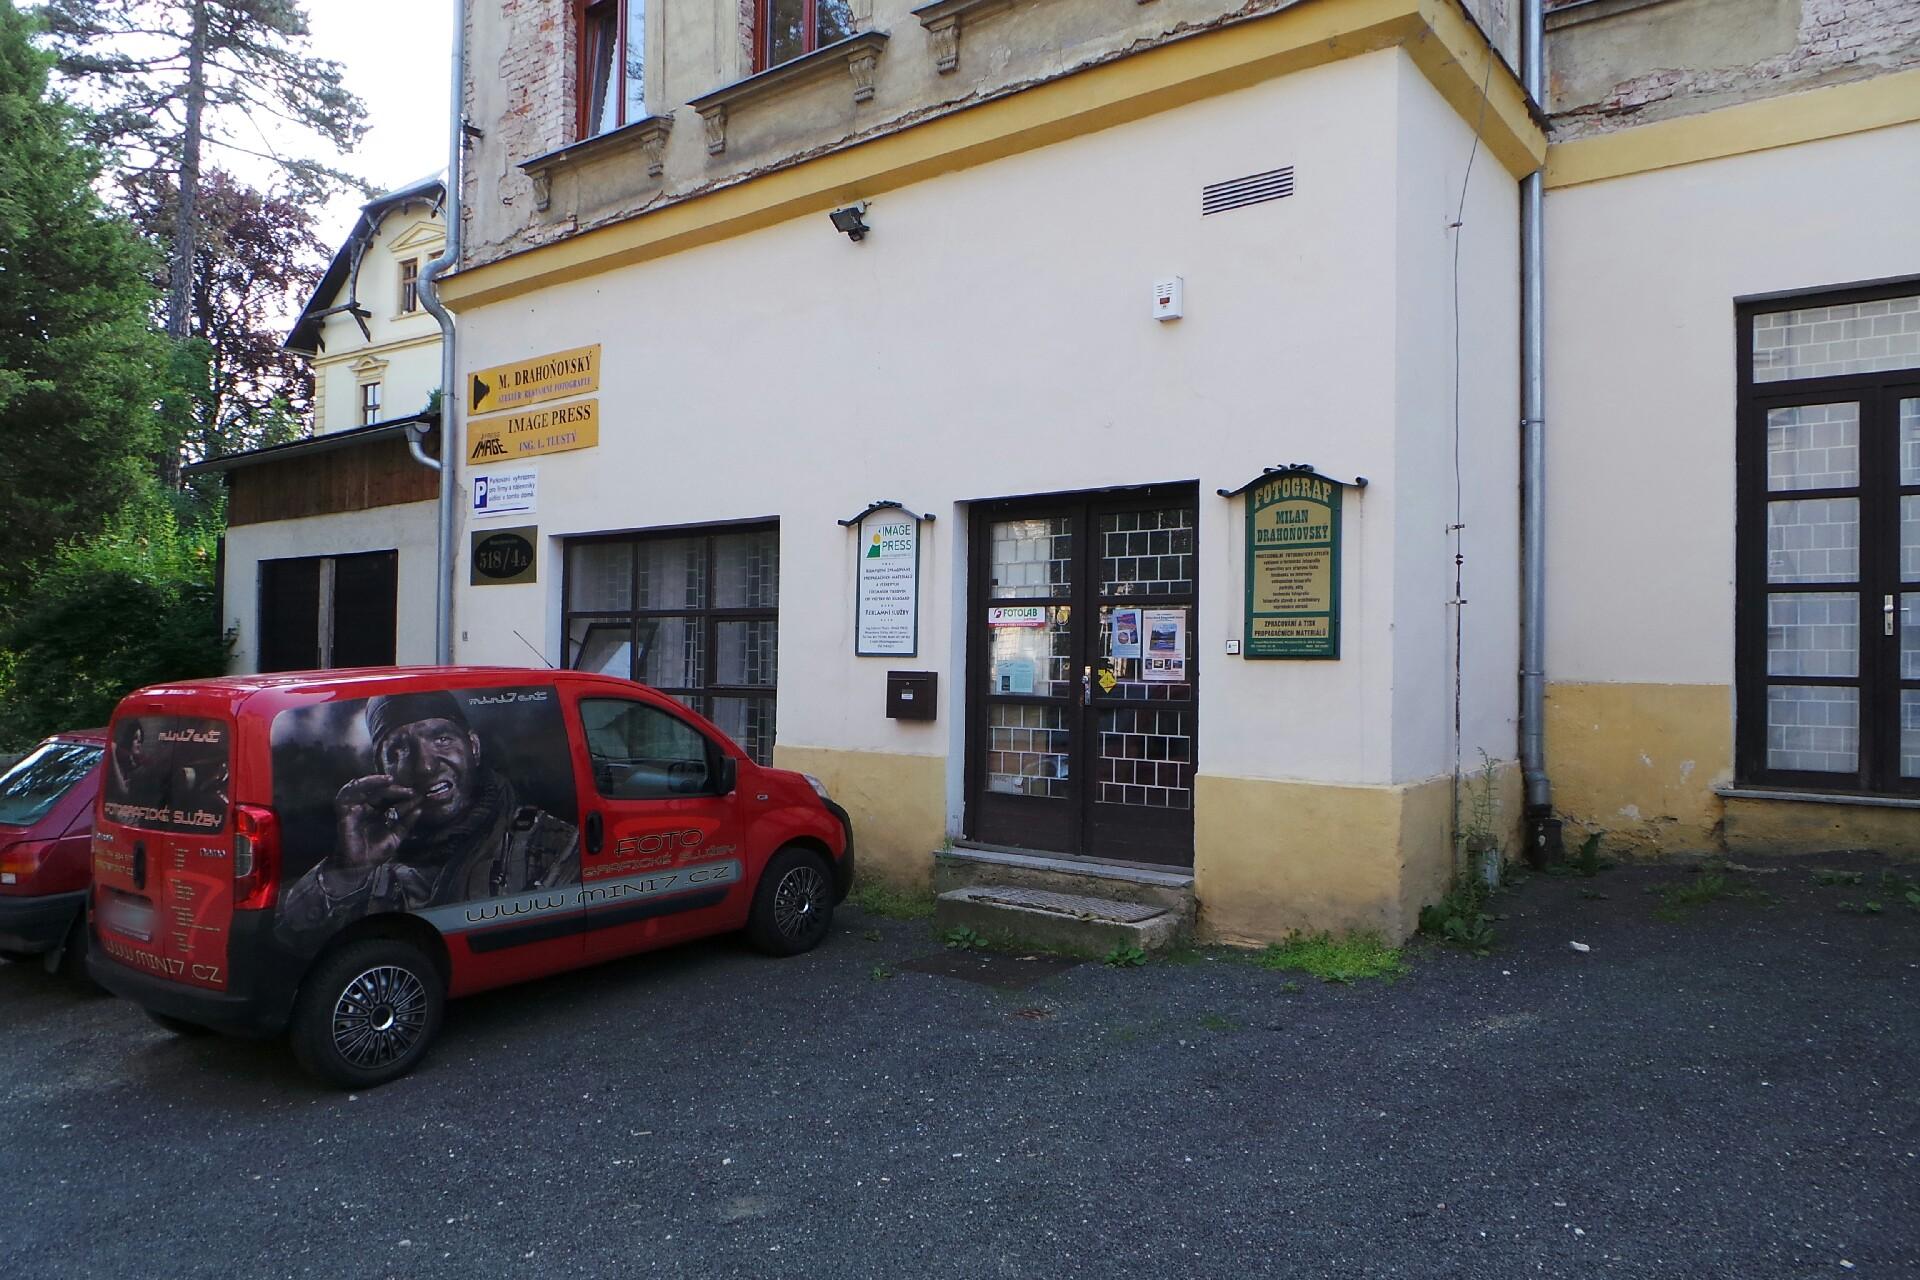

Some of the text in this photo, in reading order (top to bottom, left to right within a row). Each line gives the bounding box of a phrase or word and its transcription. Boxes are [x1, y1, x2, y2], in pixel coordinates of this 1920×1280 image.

[498, 350, 593, 390] M. DRAHOŇOVSKÝ
[508, 404, 591, 434] IMAGE PRESS
[472, 438, 508, 458] IMAGE
[520, 440, 535, 452] ING.
[476, 481, 486, 504] P
[1254, 477, 1332, 510] FOTOGRAF
[1276, 510, 1309, 524] MILAN
[882, 524, 911, 536] IMAGE
[1257, 524, 1329, 542] DRAHOŇOVSKÝ
[882, 540, 912, 551] PRESS
[1003, 608, 1038, 617] FOTOLAB
[174, 809, 222, 828] SLUŽBY
[615, 829, 704, 856] FOTO
